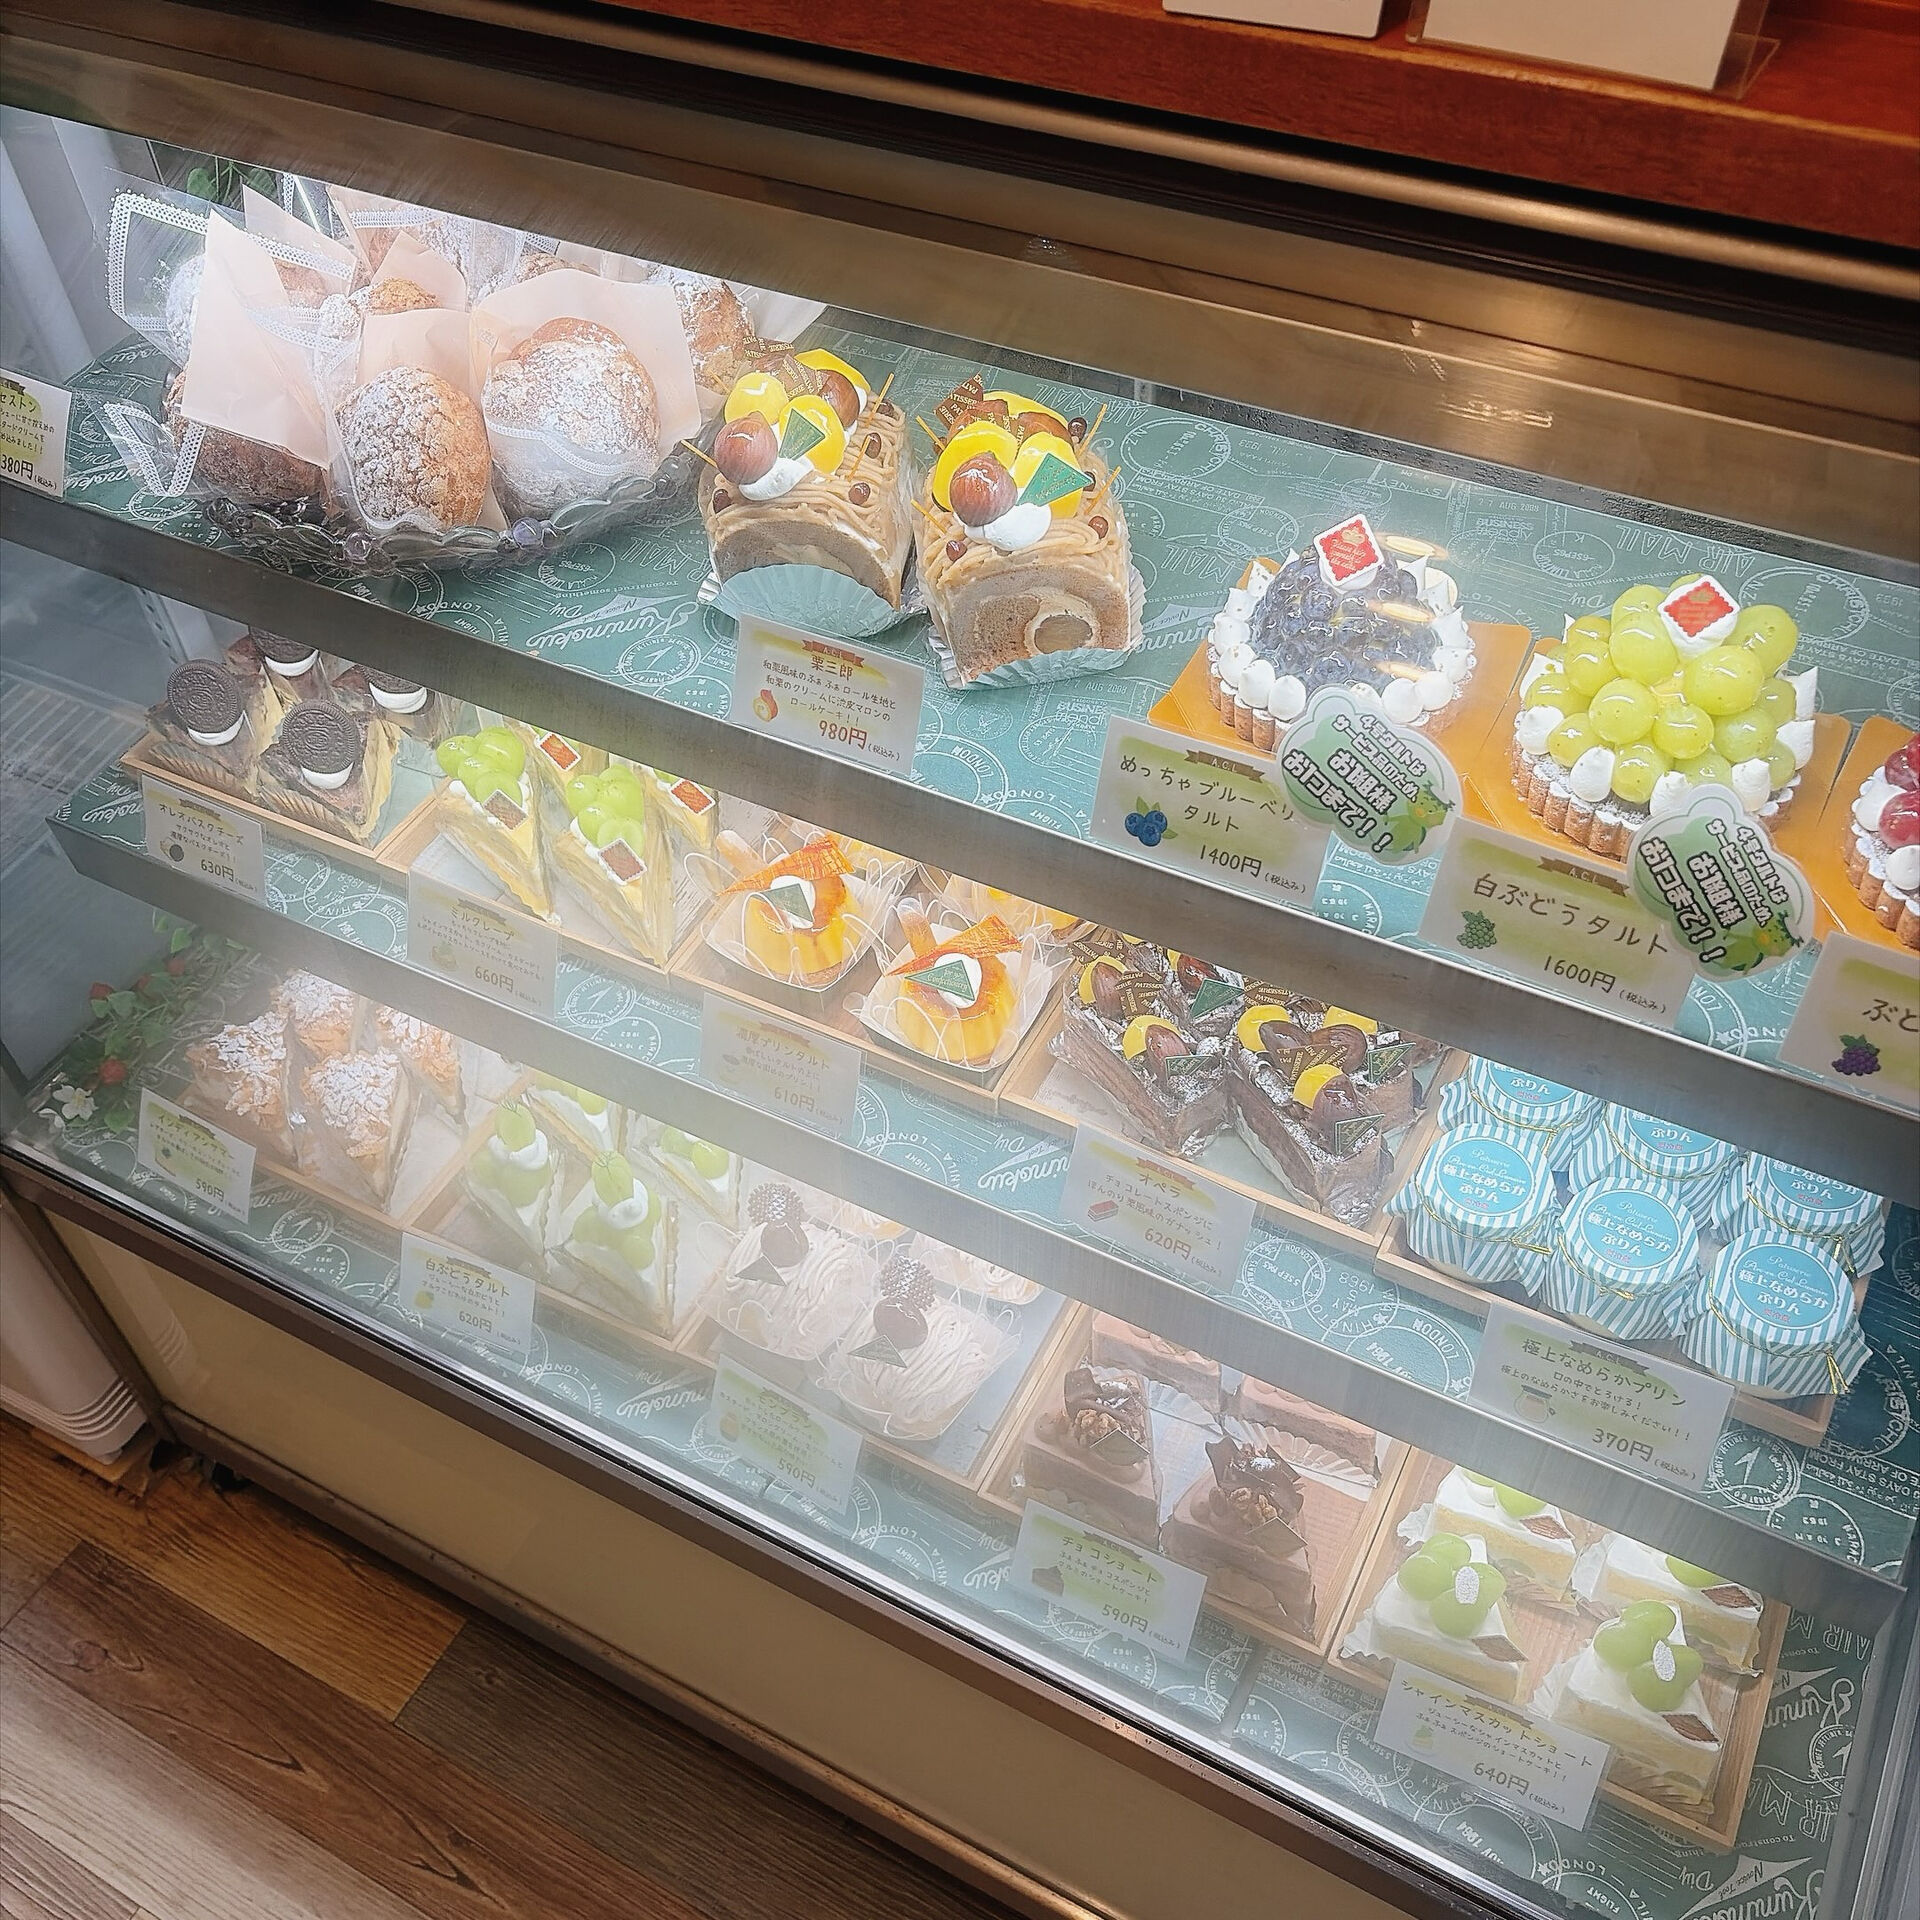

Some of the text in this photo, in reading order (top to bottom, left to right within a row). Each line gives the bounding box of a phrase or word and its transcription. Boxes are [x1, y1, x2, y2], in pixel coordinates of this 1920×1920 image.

[1, 454, 33, 480] 380円
[621, 537, 690, 576] MAIL
[1614, 523, 1693, 565] MAIL
[1161, 543, 1236, 583] MAIL
[811, 656, 854, 681] 栗三郎
[819, 720, 900, 761] 980円 （税込み）
[1360, 714, 1426, 777] 4号タルトは
[950, 744, 995, 778] LONDON
[1332, 714, 1420, 803] サービス品のため、
[1028, 809, 1064, 830] FLIGHT
[1183, 804, 1240, 832] タルト
[201, 859, 234, 881] 630円
[1200, 844, 1306, 894] 1400円 （税込み）
[1705, 818, 1773, 928] サービス品のため、
[1737, 826, 1789, 905] 4号タルトは
[451, 906, 514, 940] ミルクレープ
[1473, 872, 1668, 955] 白ぶどうタルト
[475, 966, 513, 993] 660円
[1543, 955, 1666, 1014] 1600円 （税込み）
[774, 1087, 815, 1112] 610円
[1510, 1076, 1550, 1095] ぷりん
[1650, 1126, 1693, 1144] ぷりん
[905, 1152, 932, 1173] FLIGHT
[1443, 1163, 1526, 1196] 極上なめらか
[1105, 1173, 1212, 1231] チョコレートスポンジに
[1139, 1171, 1181, 1198] オペラ
[1459, 1183, 1499, 1203] ぷりん
[1791, 1179, 1832, 1200] ぷりん
[1144, 1228, 1192, 1261] 620円
[1588, 1211, 1671, 1252] 極上なめらか
[1601, 1233, 1642, 1256] ぷりん
[425, 1257, 510, 1297] 白ぶどうタルト
[1739, 1269, 1828, 1308] 極上なめらか
[1757, 1291, 1801, 1315] ぷりん
[458, 1311, 492, 1333] 620円
[1412, 1318, 1461, 1360] LONDON
[1522, 1338, 1687, 1406] 極上なめらかプリン
[1553, 1371, 1641, 1410] 口の中でとろける！
[759, 1393, 811, 1429] モンブラン
[1591, 1428, 1696, 1480] 370円 （税込み）
[1807, 1448, 1911, 1497] DAYS STAY FROM
[1062, 1535, 1157, 1584] チョコショート
[1102, 1604, 1149, 1633] 590円
[1402, 1679, 1593, 1767] シャインマスカットショート
[1428, 1708, 1561, 1770] ジューシーなシャインマスカットと
[1473, 1762, 1530, 1796] 640円
[1677, 1866, 1715, 1891] Diy
[1586, 1886, 1620, 1913] FLIGHT
